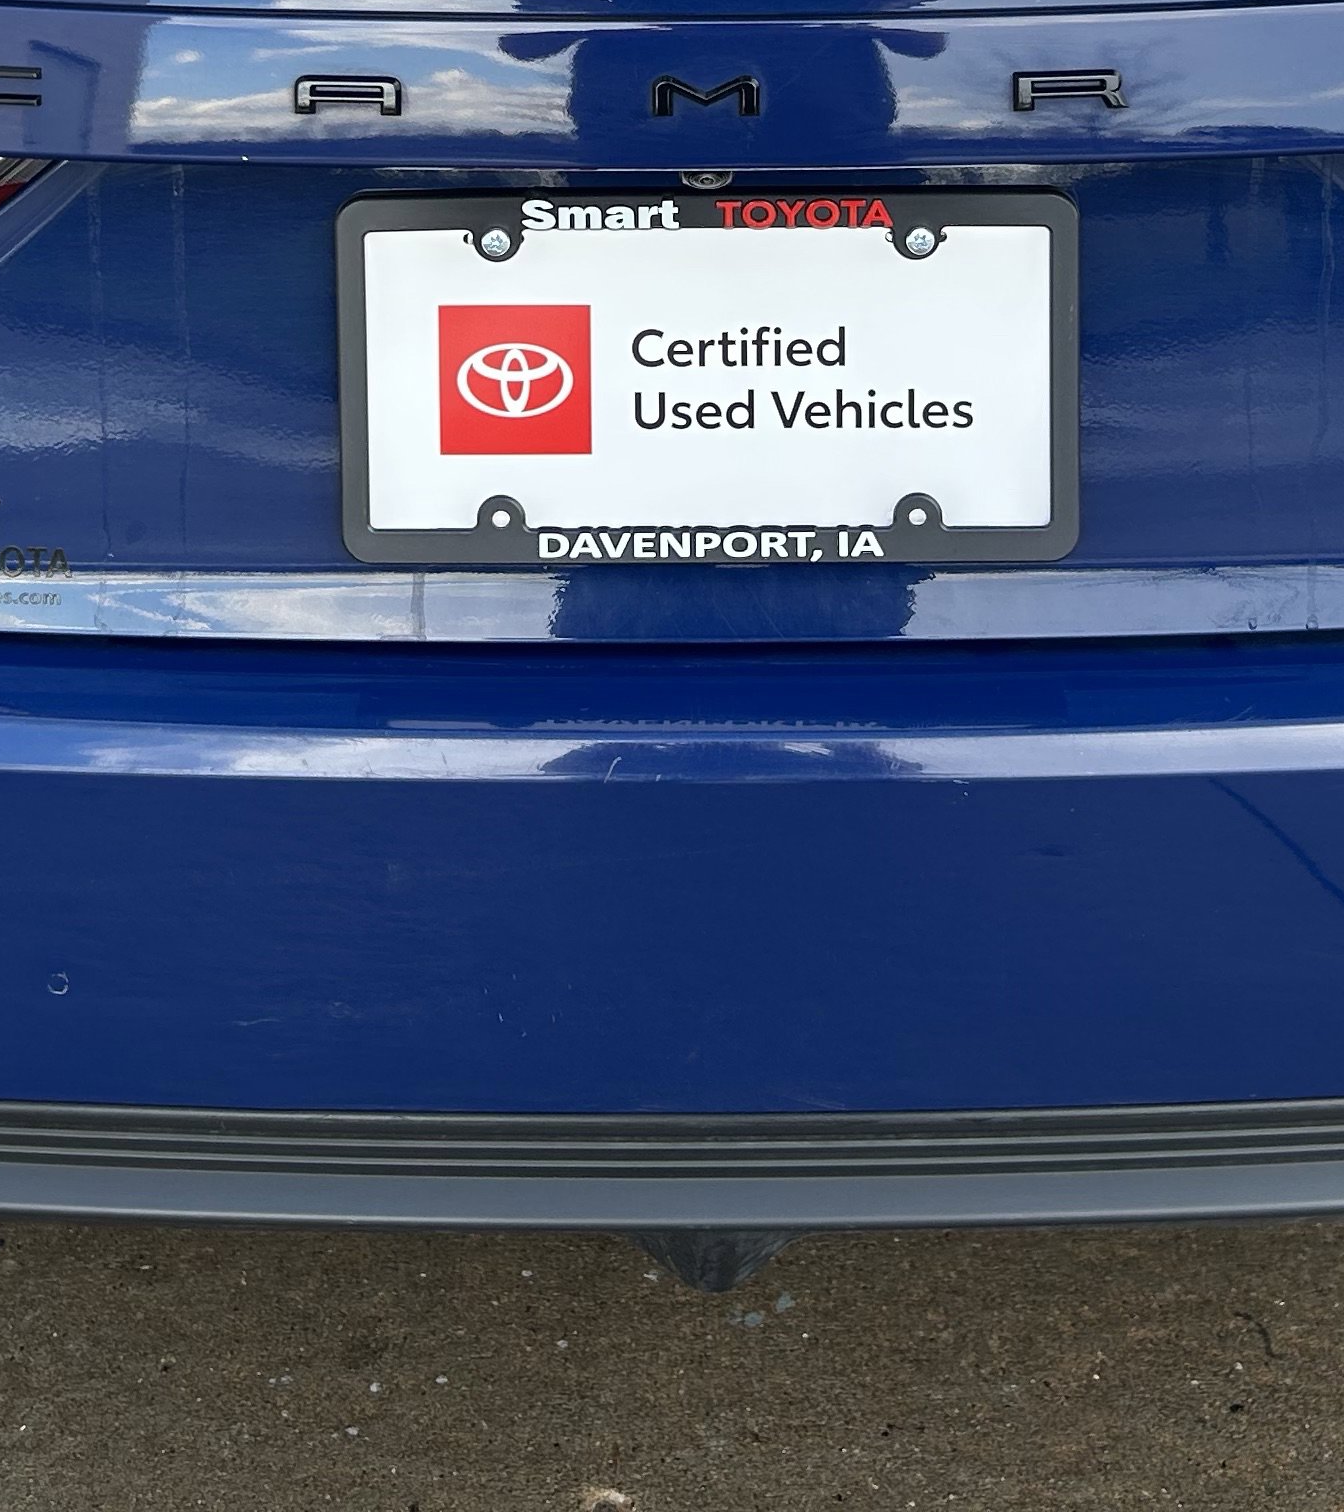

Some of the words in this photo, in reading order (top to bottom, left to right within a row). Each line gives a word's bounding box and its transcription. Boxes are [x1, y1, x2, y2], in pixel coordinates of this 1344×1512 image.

[521, 199, 679, 230] Smart
[715, 199, 894, 230] TOYOTA
[632, 326, 846, 368] Certified
[634, 388, 754, 429] Used
[771, 388, 974, 429] Vehicles
[538, 531, 823, 562] DAVENPORT,
[839, 531, 884, 557] IA
